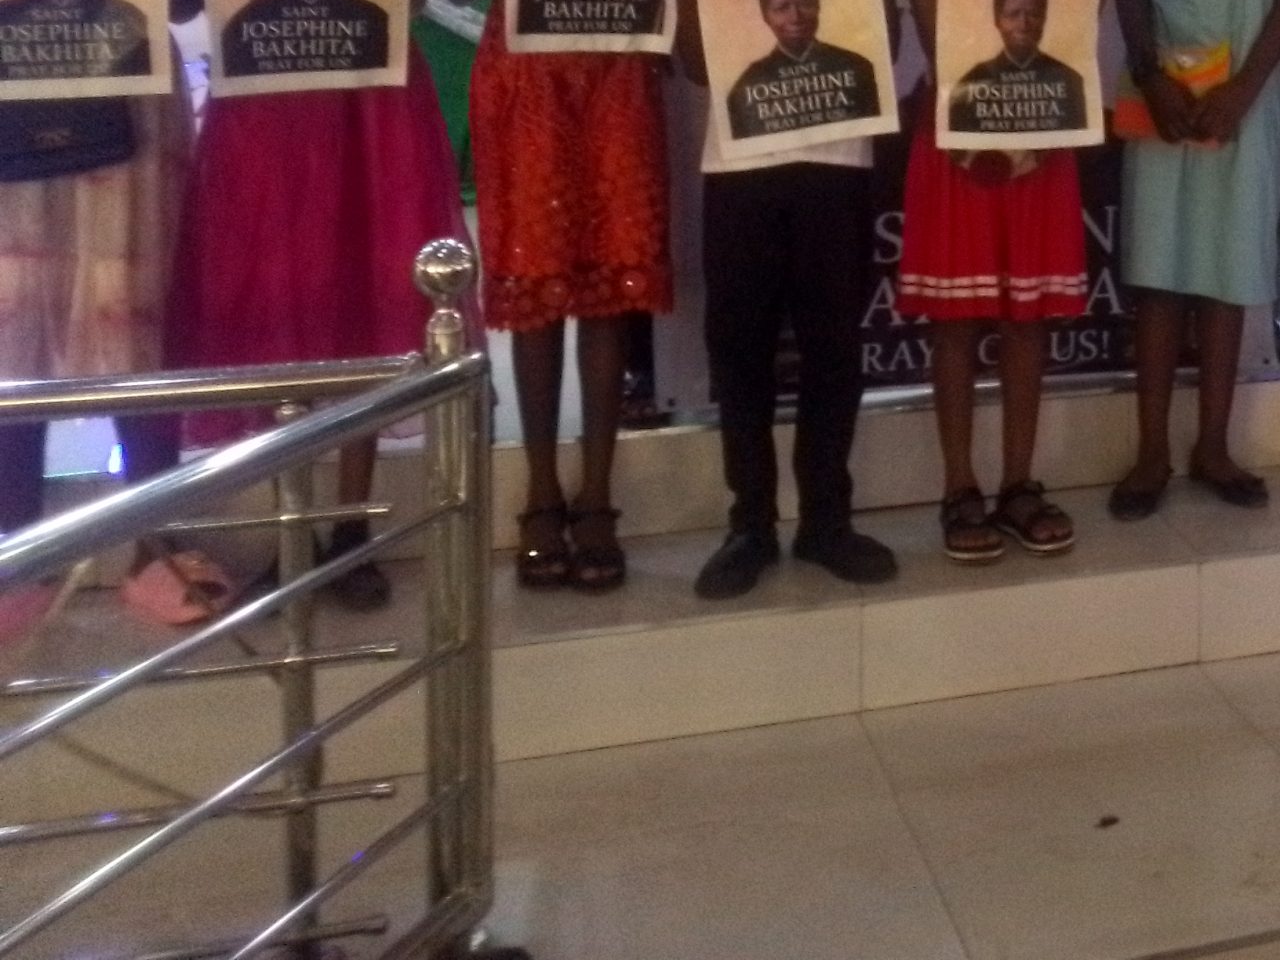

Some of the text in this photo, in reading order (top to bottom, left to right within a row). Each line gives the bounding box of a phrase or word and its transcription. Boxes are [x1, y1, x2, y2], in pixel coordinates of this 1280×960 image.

[281, 6, 330, 18] SAINT
[0, 22, 126, 41] OSEPHINE
[241, 20, 368, 42] JOSEPHINE
[258, 60, 293, 71] PRAY
[297, 58, 326, 69] FOR
[778, 62, 818, 78] SAINT
[1000, 70, 1037, 81] SAINT
[745, 70, 856, 105] JOSEPHINE
[967, 82, 1067, 102] JOSEPHINE
[765, 119, 797, 131] PRAY
[861, 338, 936, 375] RAY
[1050, 328, 1110, 363] US!
